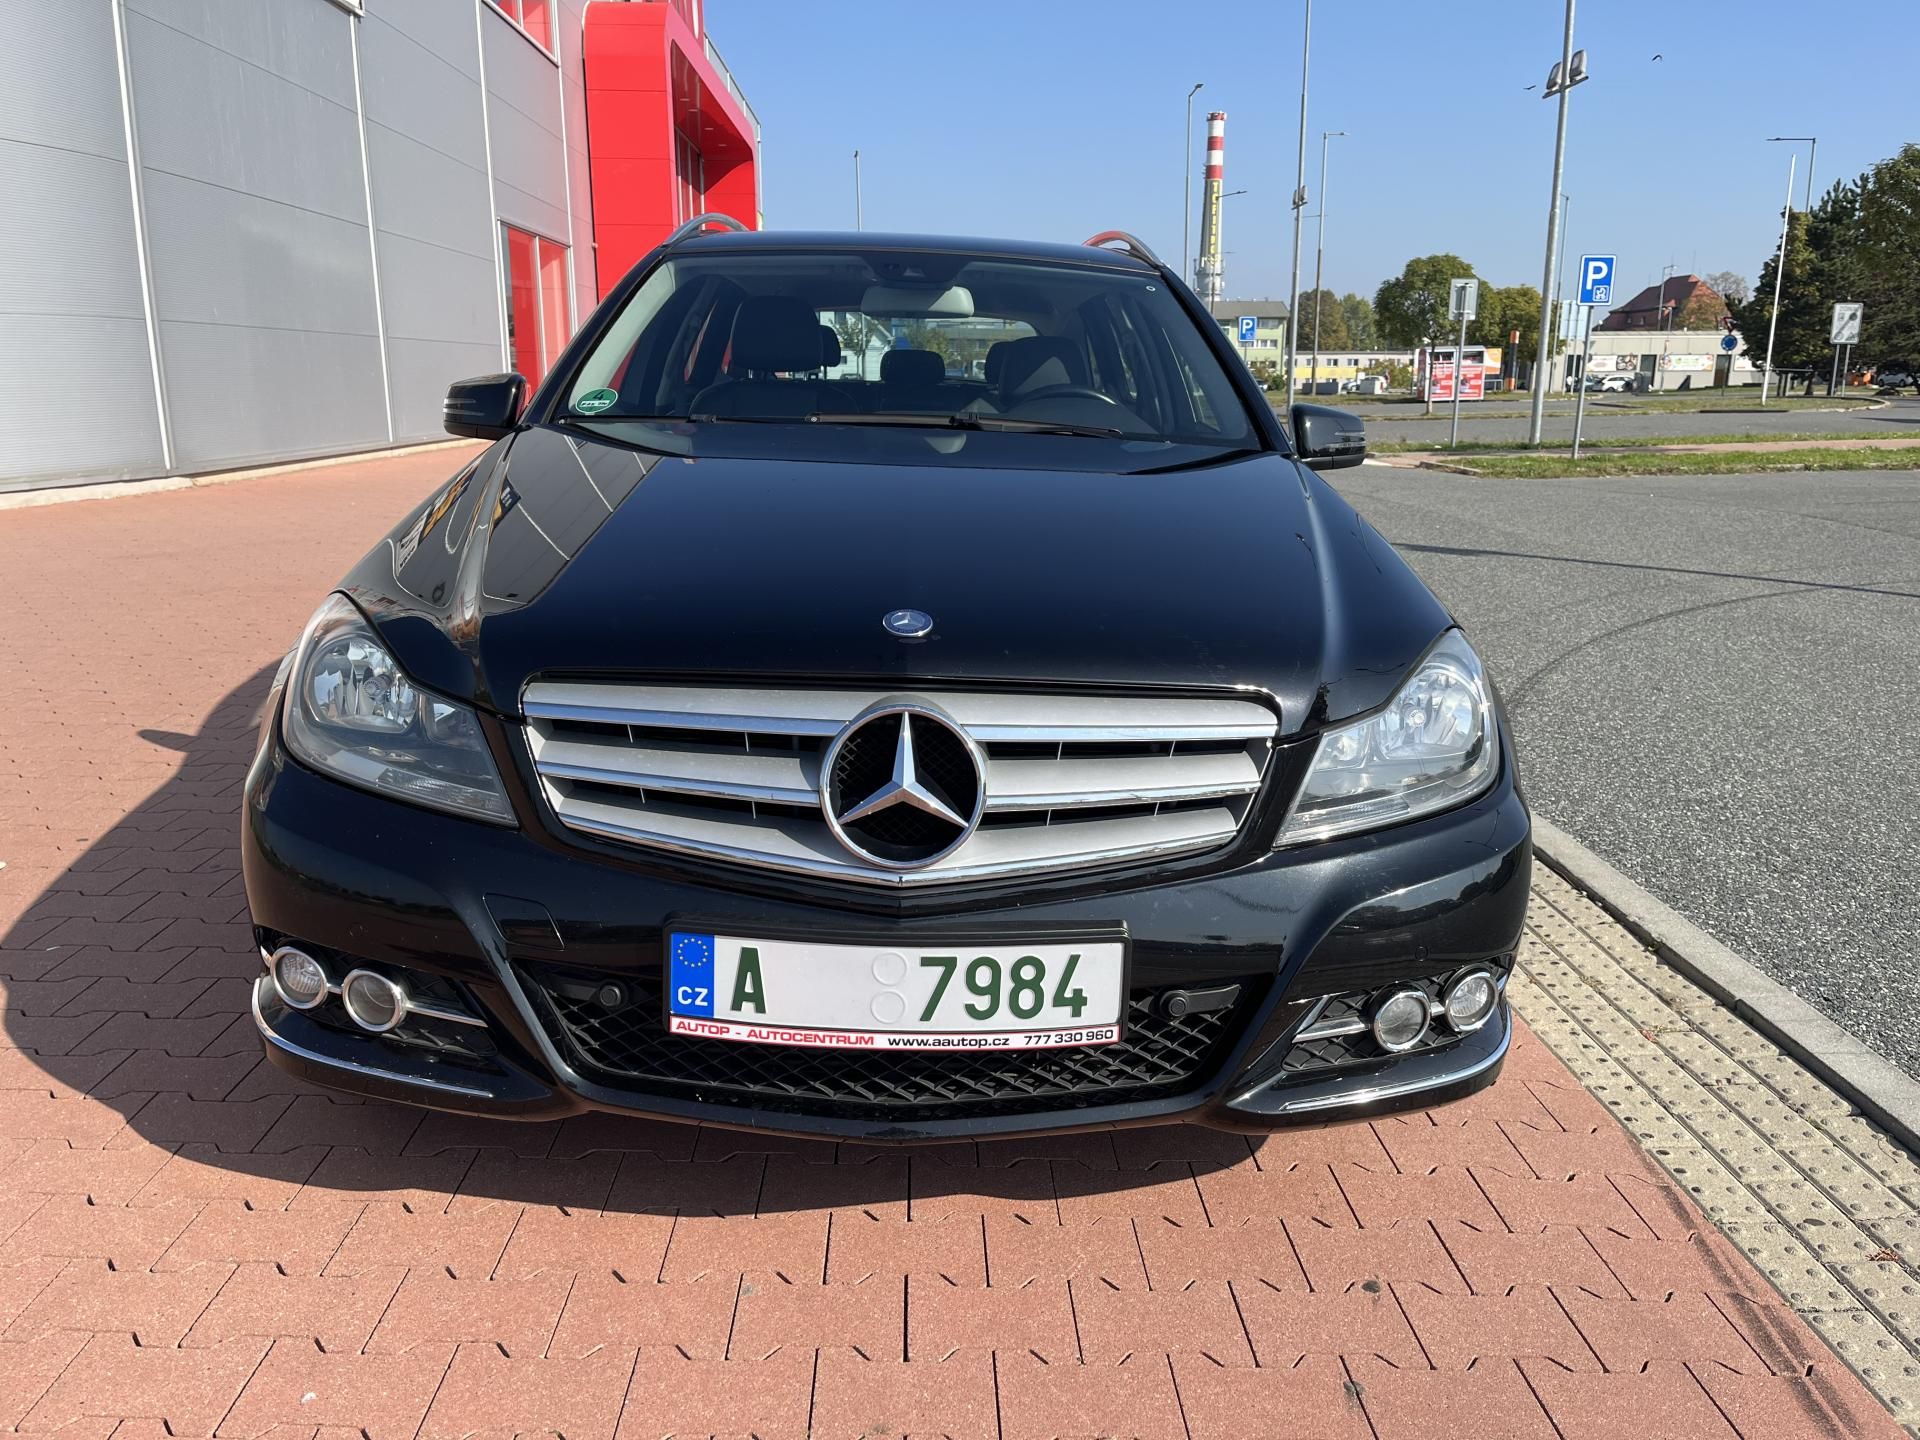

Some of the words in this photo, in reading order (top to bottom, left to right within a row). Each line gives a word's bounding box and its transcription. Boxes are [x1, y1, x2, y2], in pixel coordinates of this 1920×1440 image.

[1586, 261, 1608, 290] P
[1242, 319, 1253, 334] P
[592, 390, 605, 400] 4
[730, 947, 767, 1014] A
[919, 954, 1088, 1021] 7984
[677, 986, 708, 1006] CZ
[676, 1021, 730, 1036] AUTOP
[747, 1029, 874, 1045] AUTOCENTRUM
[887, 1037, 1010, 1048] www.aautop.cz
[1023, 1034, 1051, 1045] 777
[1054, 1032, 1083, 1043] 330
[1086, 1029, 1114, 1041] 960
